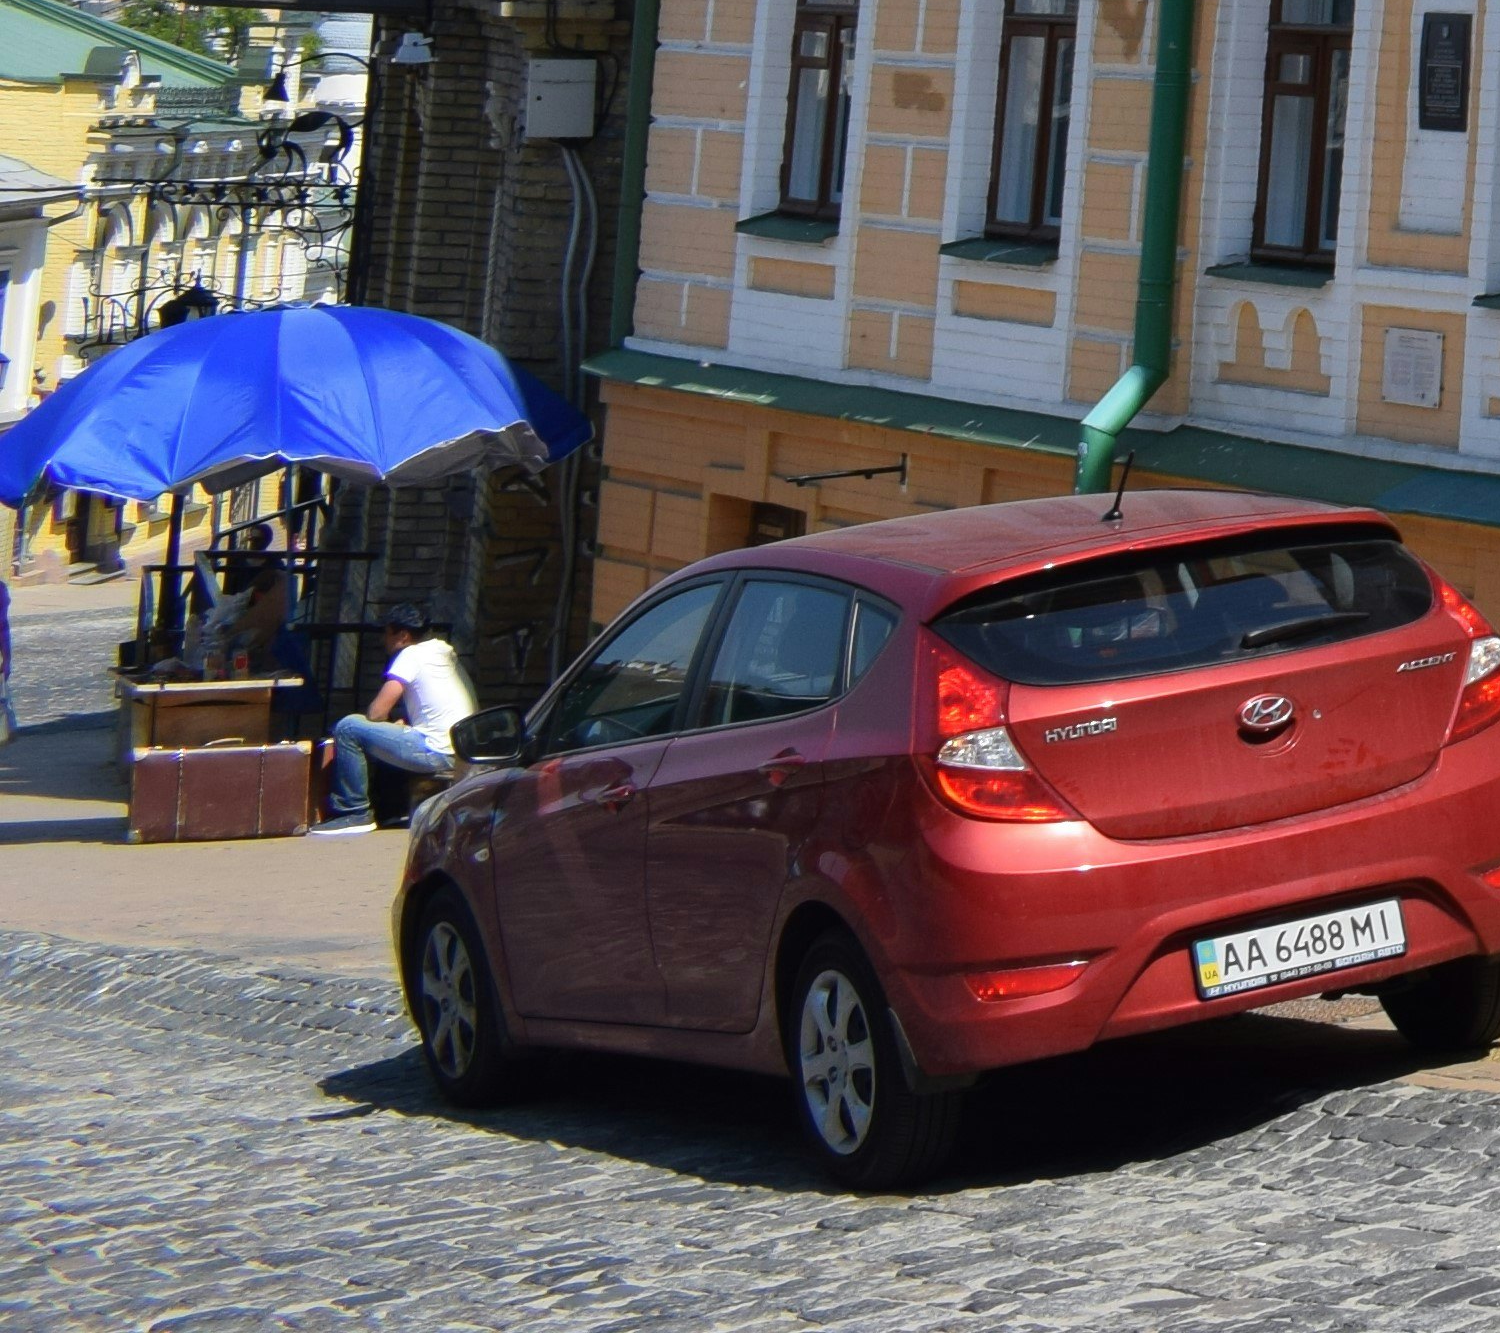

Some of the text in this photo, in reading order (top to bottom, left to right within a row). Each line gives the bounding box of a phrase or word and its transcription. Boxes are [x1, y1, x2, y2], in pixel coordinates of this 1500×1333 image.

[1397, 652, 1457, 673] ACCENT
[1045, 717, 1117, 743] HYUNDAI
[1223, 909, 1390, 976] AA 6488 MI
[1204, 970, 1219, 980] UA
